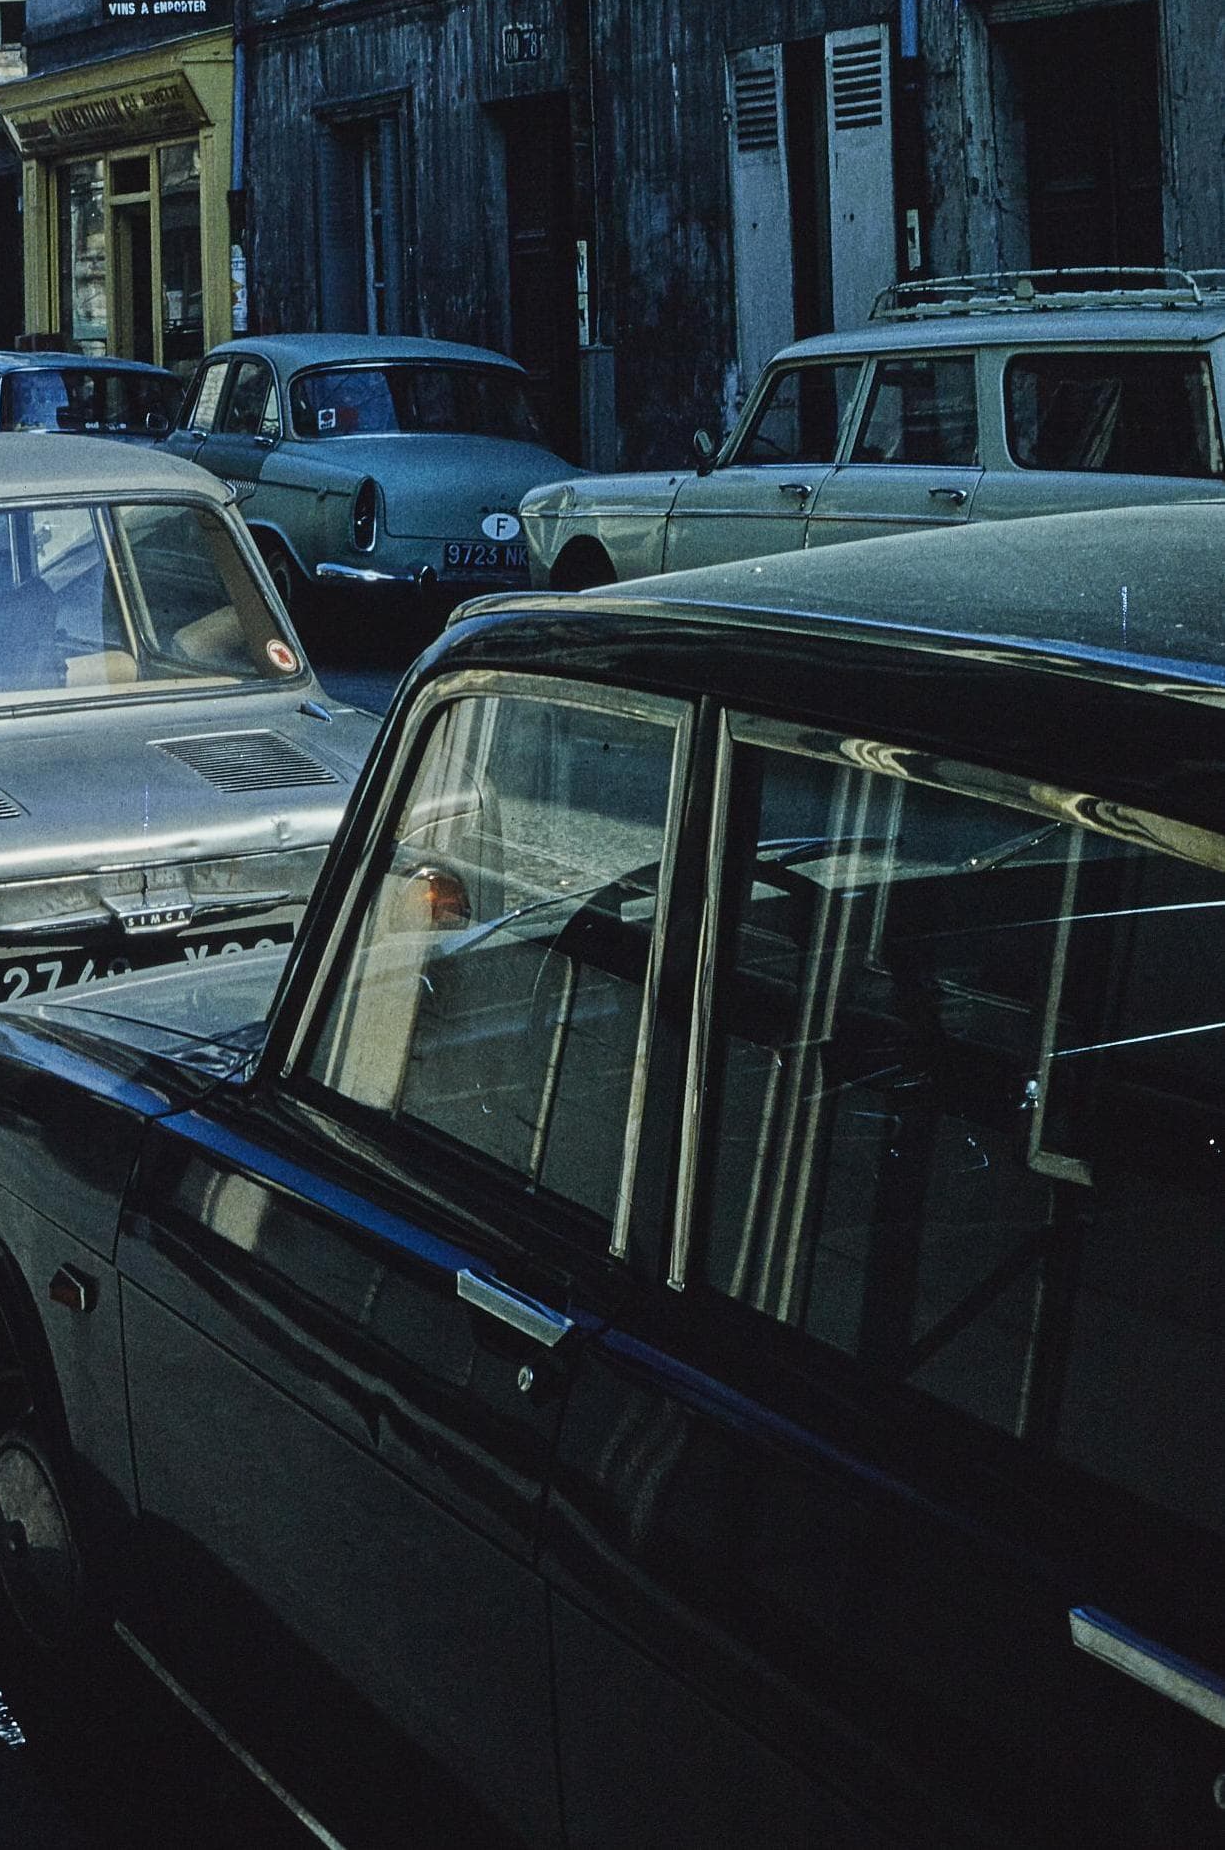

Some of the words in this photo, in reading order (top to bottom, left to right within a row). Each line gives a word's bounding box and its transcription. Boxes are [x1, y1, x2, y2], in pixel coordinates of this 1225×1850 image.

[109, 3, 136, 15] VINS
[141, 2, 149, 14] A
[154, 0, 206, 14] EMPORTER
[496, 518, 508, 537] F
[128, 911, 185, 927] SIMCA
